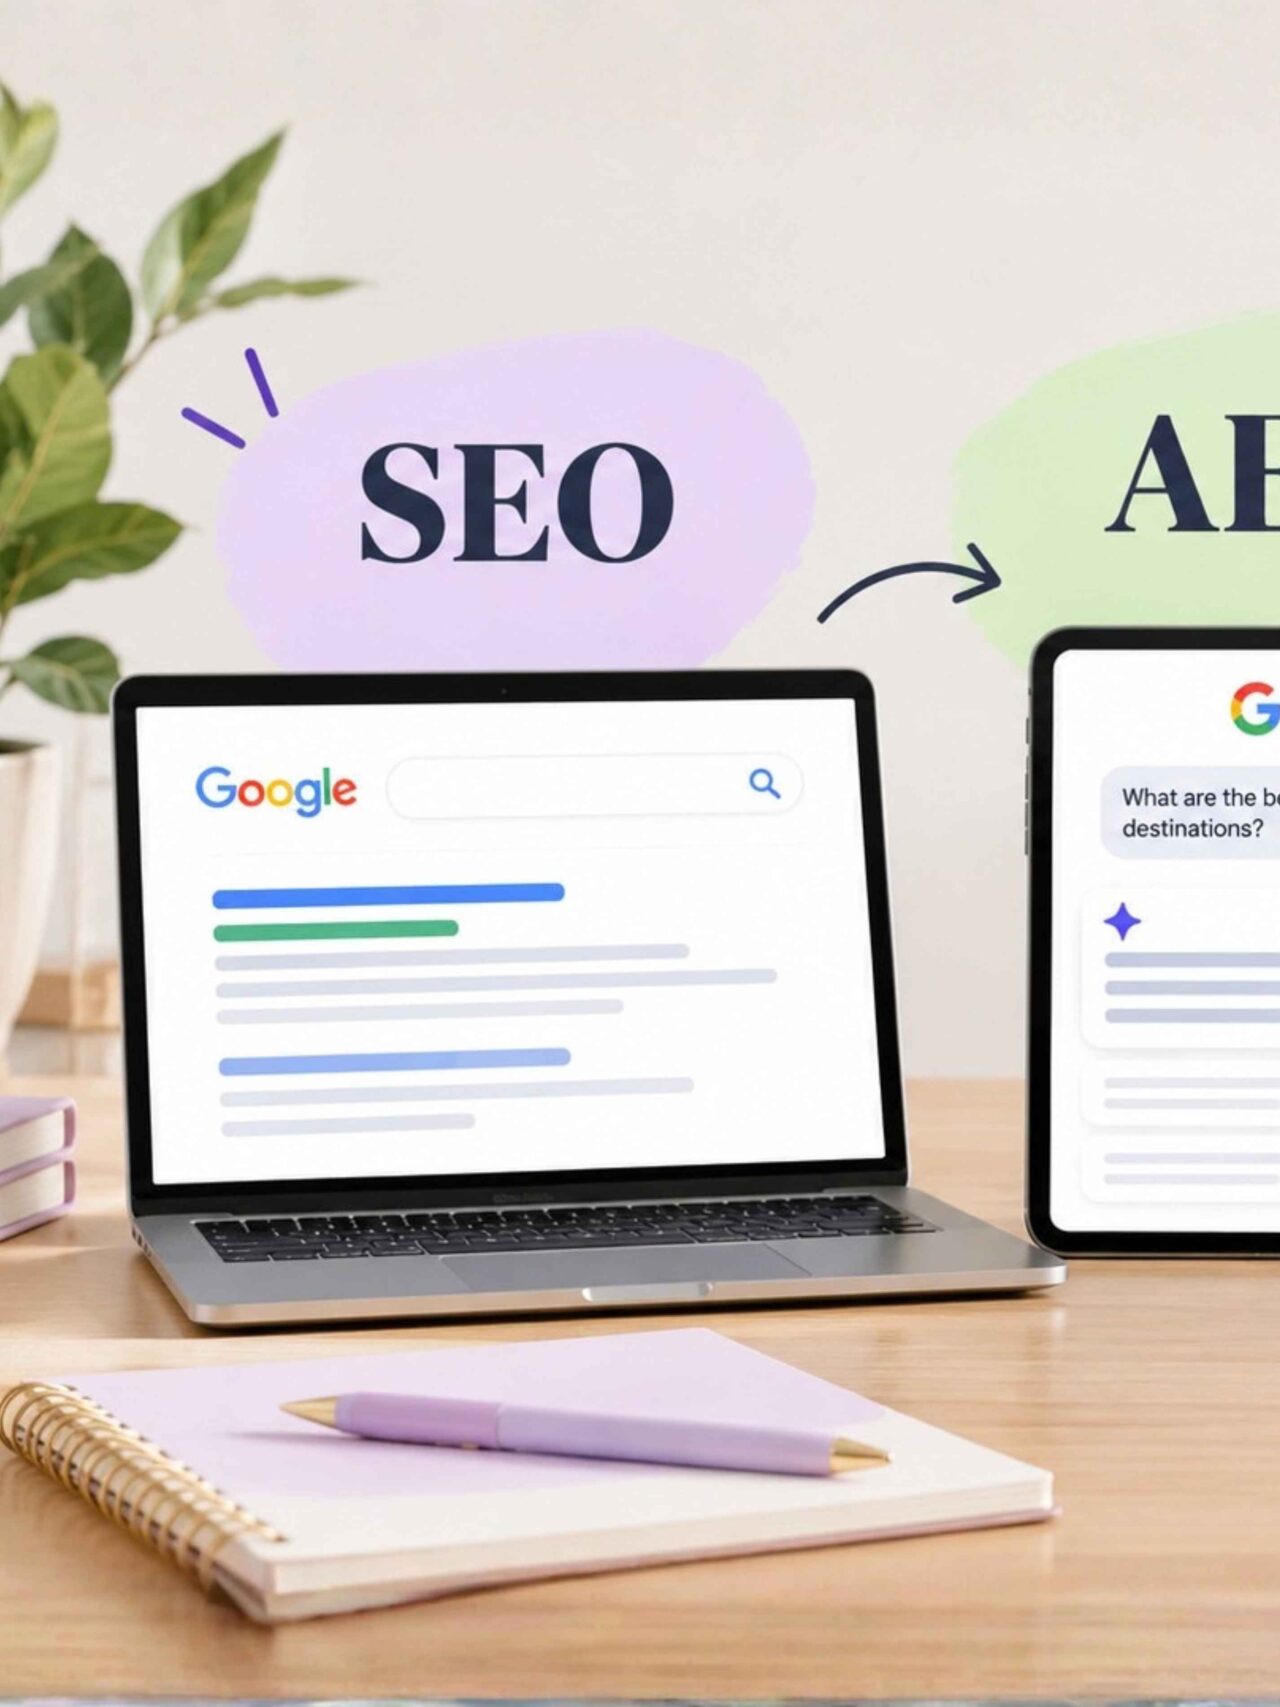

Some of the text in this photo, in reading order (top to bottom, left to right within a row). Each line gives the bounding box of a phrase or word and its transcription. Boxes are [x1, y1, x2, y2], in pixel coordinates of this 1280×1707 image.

[194, 765, 358, 819] Google
[1121, 787, 1178, 808] What
[1183, 791, 1217, 808] are
[1222, 787, 1257, 808] the
[1121, 817, 1264, 839] destinations?
